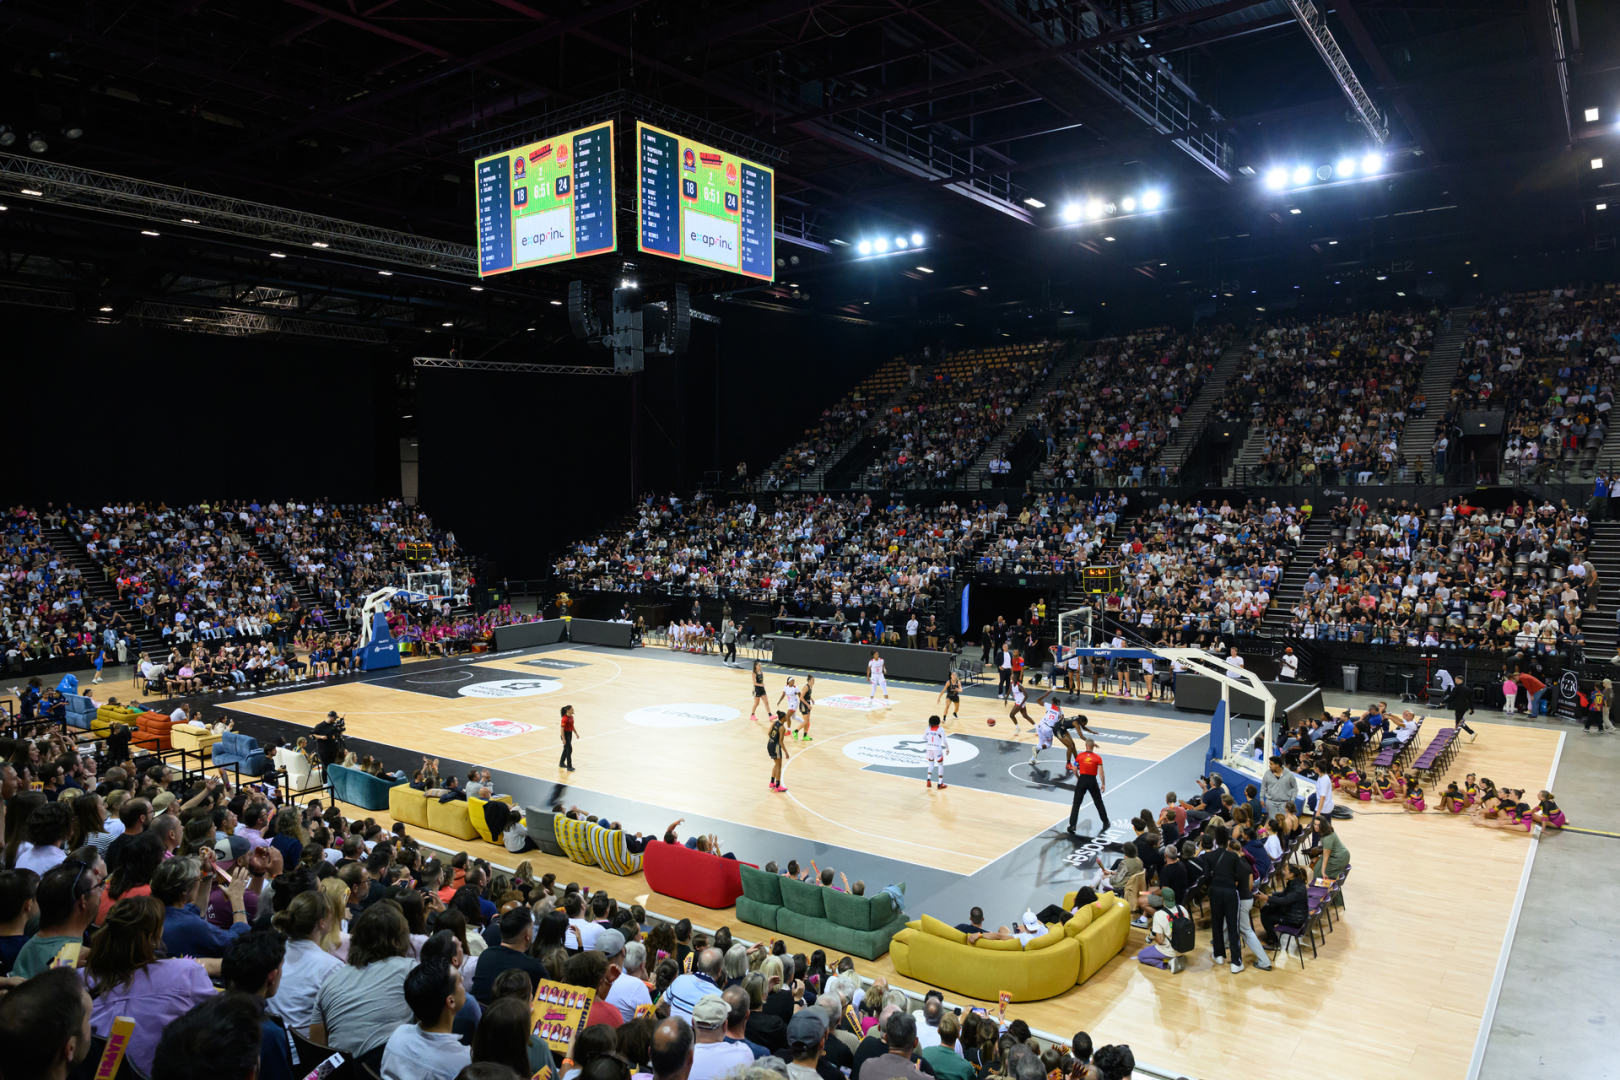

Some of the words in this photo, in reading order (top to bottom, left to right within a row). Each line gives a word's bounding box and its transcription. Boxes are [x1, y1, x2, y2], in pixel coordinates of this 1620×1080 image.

[534, 182, 550, 199] 6:51
[558, 178, 568, 192] 24
[686, 182, 695, 195] 18
[517, 189, 525, 202] 18
[704, 186, 720, 204] 6:51
[728, 194, 736, 208] 24
[522, 226, 564, 246] exaprint
[690, 232, 732, 250] exaprint
[1596, 696, 1602, 704] 10
[584, 998, 592, 1010] LES
